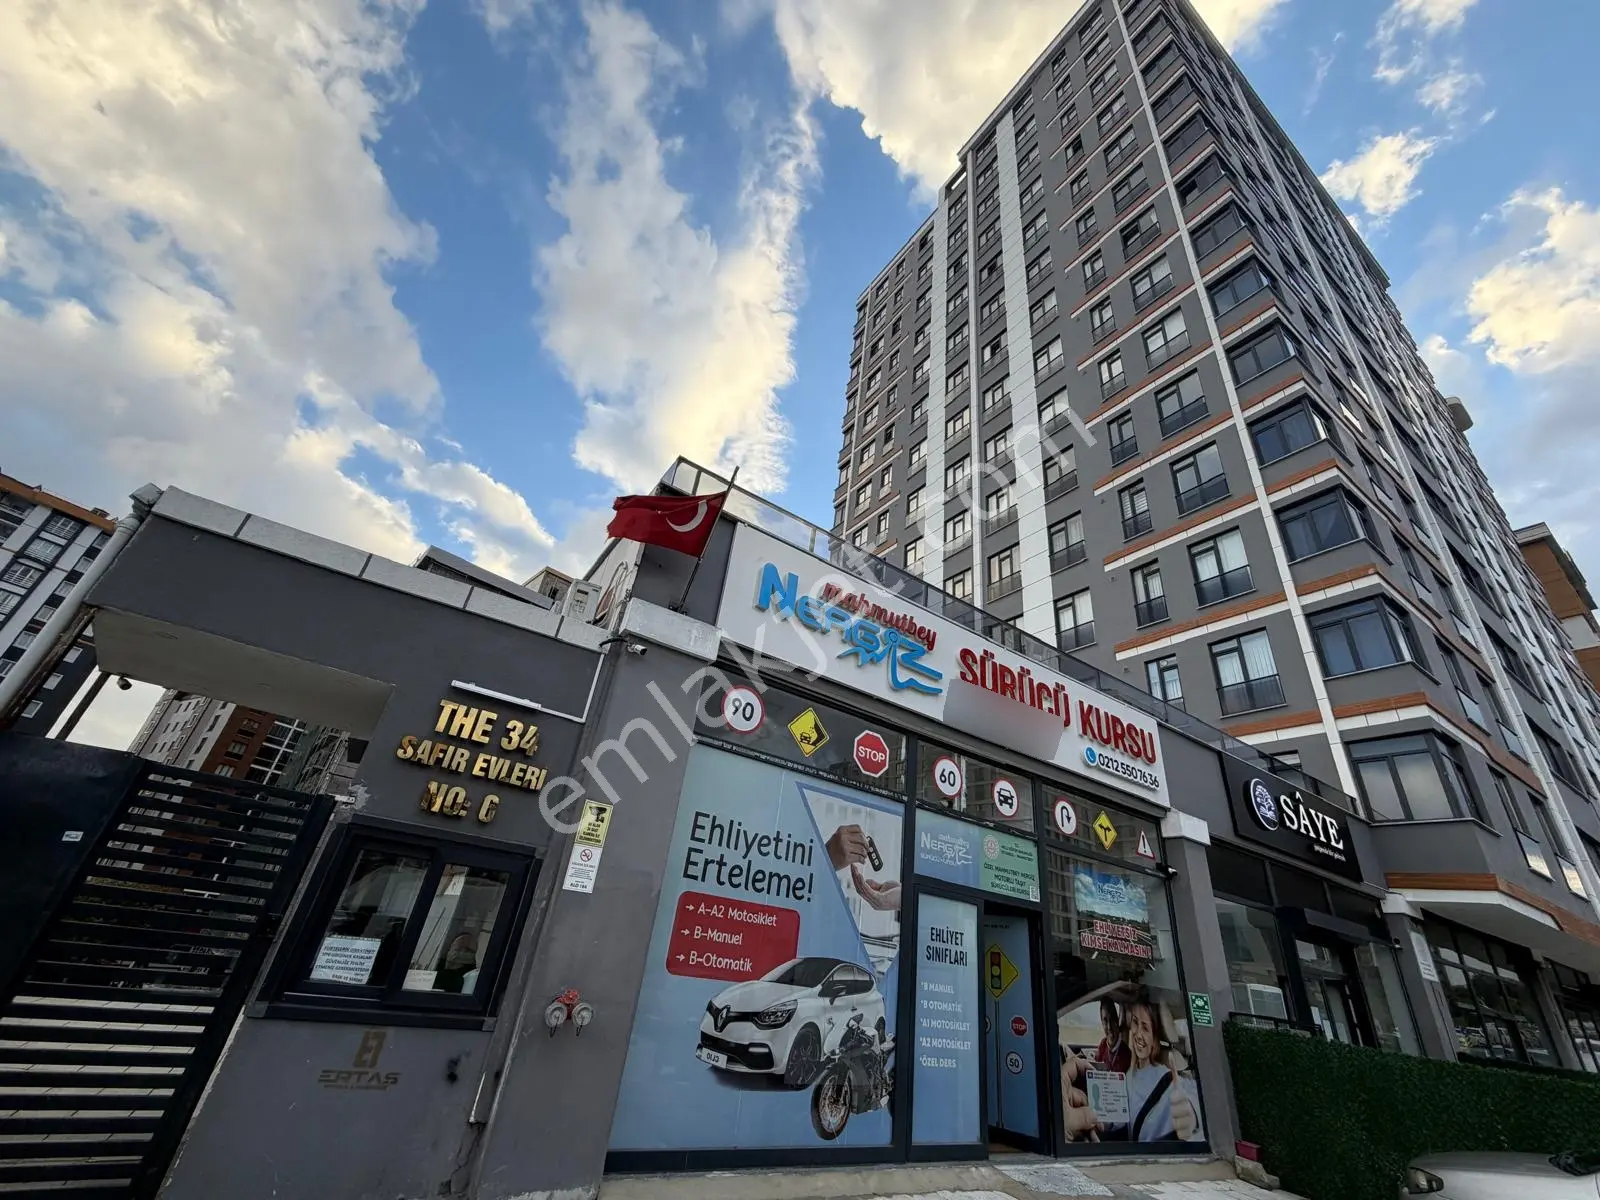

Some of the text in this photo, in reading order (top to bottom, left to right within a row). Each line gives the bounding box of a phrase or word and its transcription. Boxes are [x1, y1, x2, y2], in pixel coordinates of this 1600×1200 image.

[821, 582, 937, 652] mahmutbey
[732, 697, 755, 722] 90
[435, 699, 540, 756] THE 34
[1078, 700, 1157, 764] KURSU
[397, 736, 470, 773] SAFIR
[858, 746, 886, 763] STOP
[939, 768, 957, 787] 60
[1280, 791, 1344, 850] SÂYE
[689, 811, 814, 867] Ehliyetini
[682, 847, 814, 902] Erteleme!
[727, 907, 778, 927] Motosiklet
[693, 926, 743, 945] B-Manuel
[930, 926, 964, 947] EHLİYET
[688, 951, 753, 972] B-Otomatik
[926, 945, 968, 967] SINIFLARI
[929, 983, 955, 994] MANUEL
[1013, 1023, 1027, 1031] STOP
[939, 1058, 957, 1069] DERS
[1010, 1058, 1020, 1069] 50
